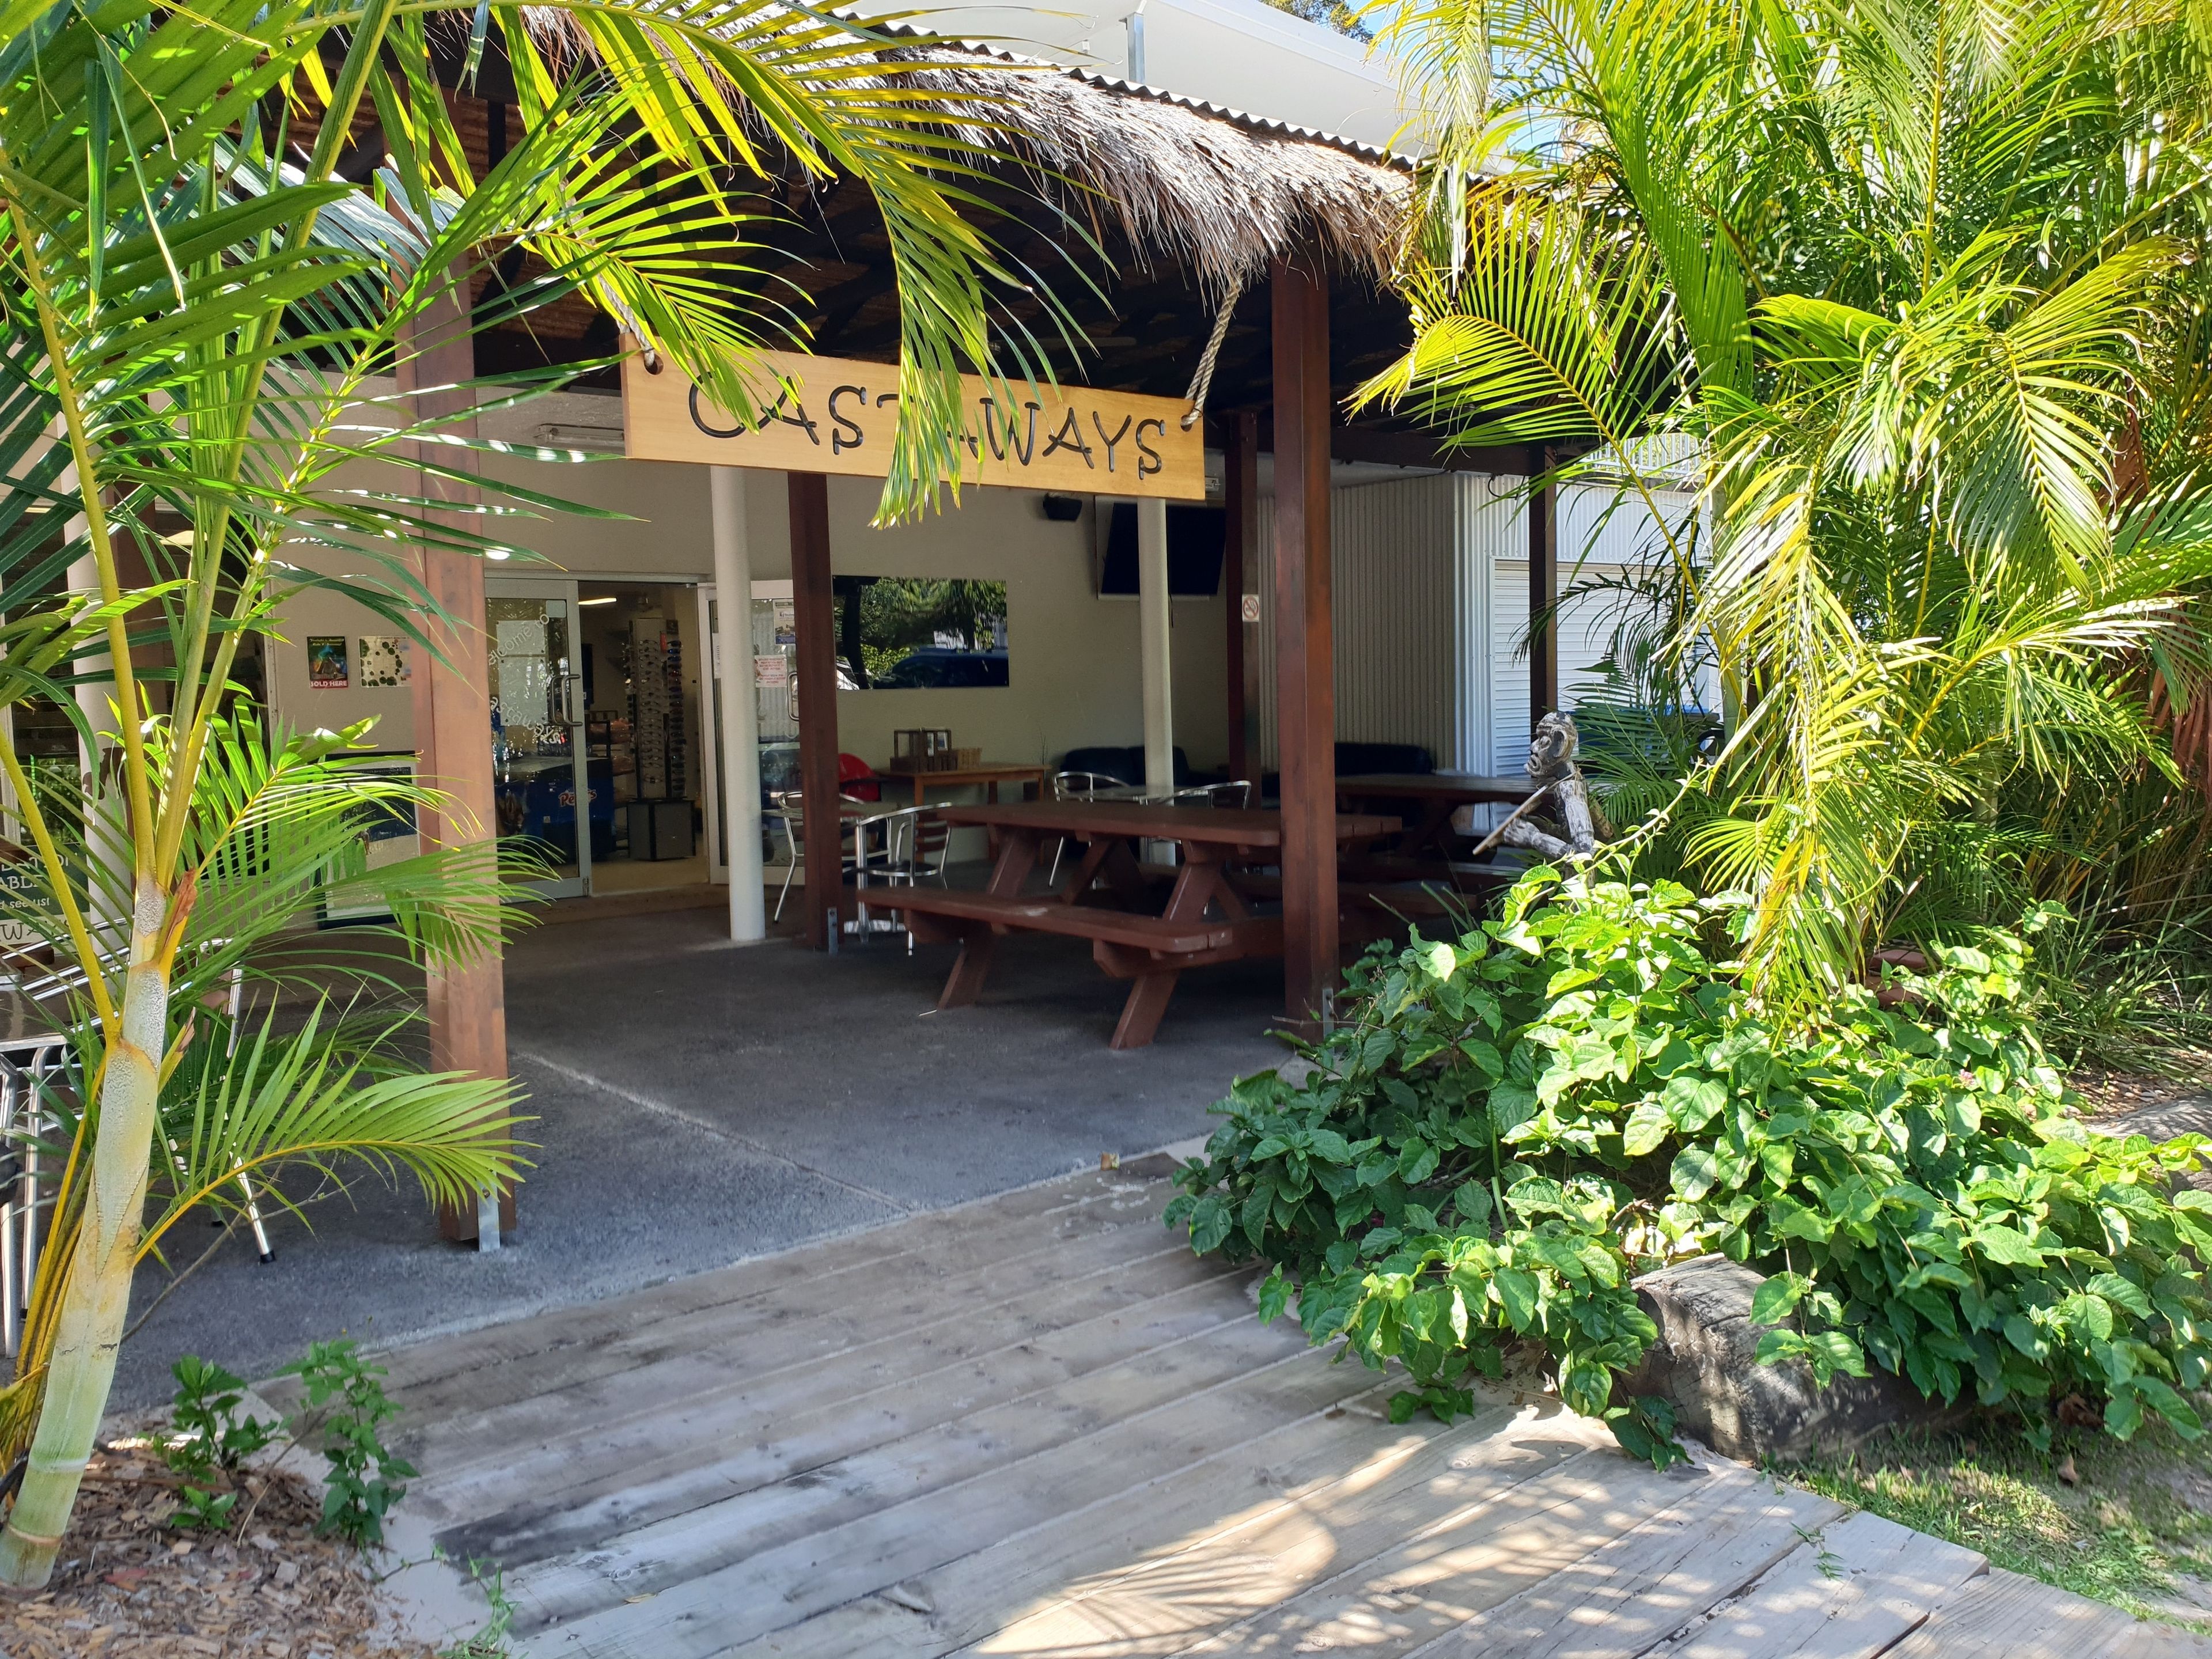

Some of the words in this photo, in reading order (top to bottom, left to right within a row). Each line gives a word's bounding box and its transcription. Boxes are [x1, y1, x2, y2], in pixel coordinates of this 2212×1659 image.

[688, 370, 1166, 481] CASWAYS
[488, 626, 533, 665] elcome
[534, 613, 550, 629] to
[490, 696, 562, 744] astaways
[558, 790, 597, 806] Pes
